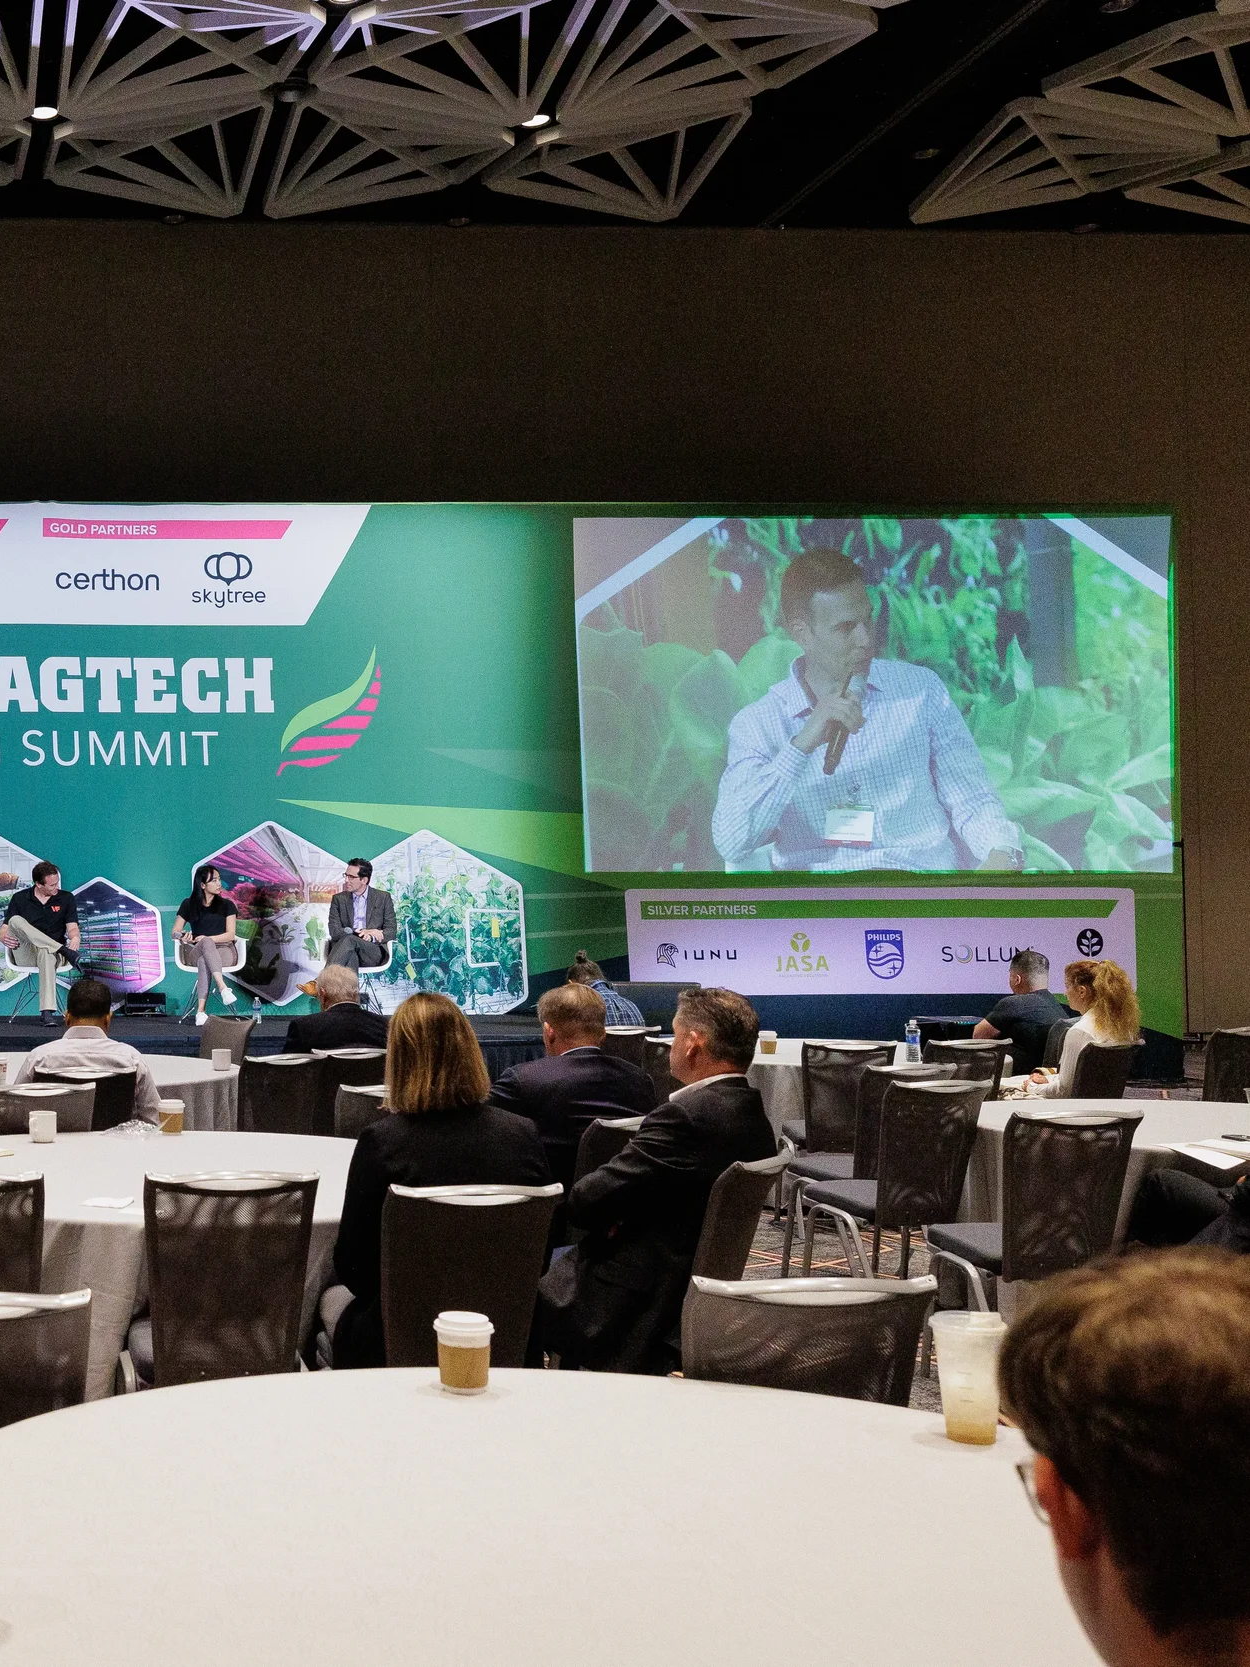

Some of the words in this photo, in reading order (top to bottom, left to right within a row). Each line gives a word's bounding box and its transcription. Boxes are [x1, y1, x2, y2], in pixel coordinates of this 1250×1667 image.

[50, 522, 87, 535] GOLD
[90, 523, 157, 536] PARTNERS
[55, 569, 159, 591] certhon
[191, 588, 266, 608] skytree
[23, 730, 218, 767] SUMMIT
[647, 904, 688, 916] SILVER
[692, 904, 757, 916] PARTNERS
[867, 933, 901, 941] PHILIPS
[684, 949, 737, 960] IUNU
[776, 955, 829, 972] JASA
